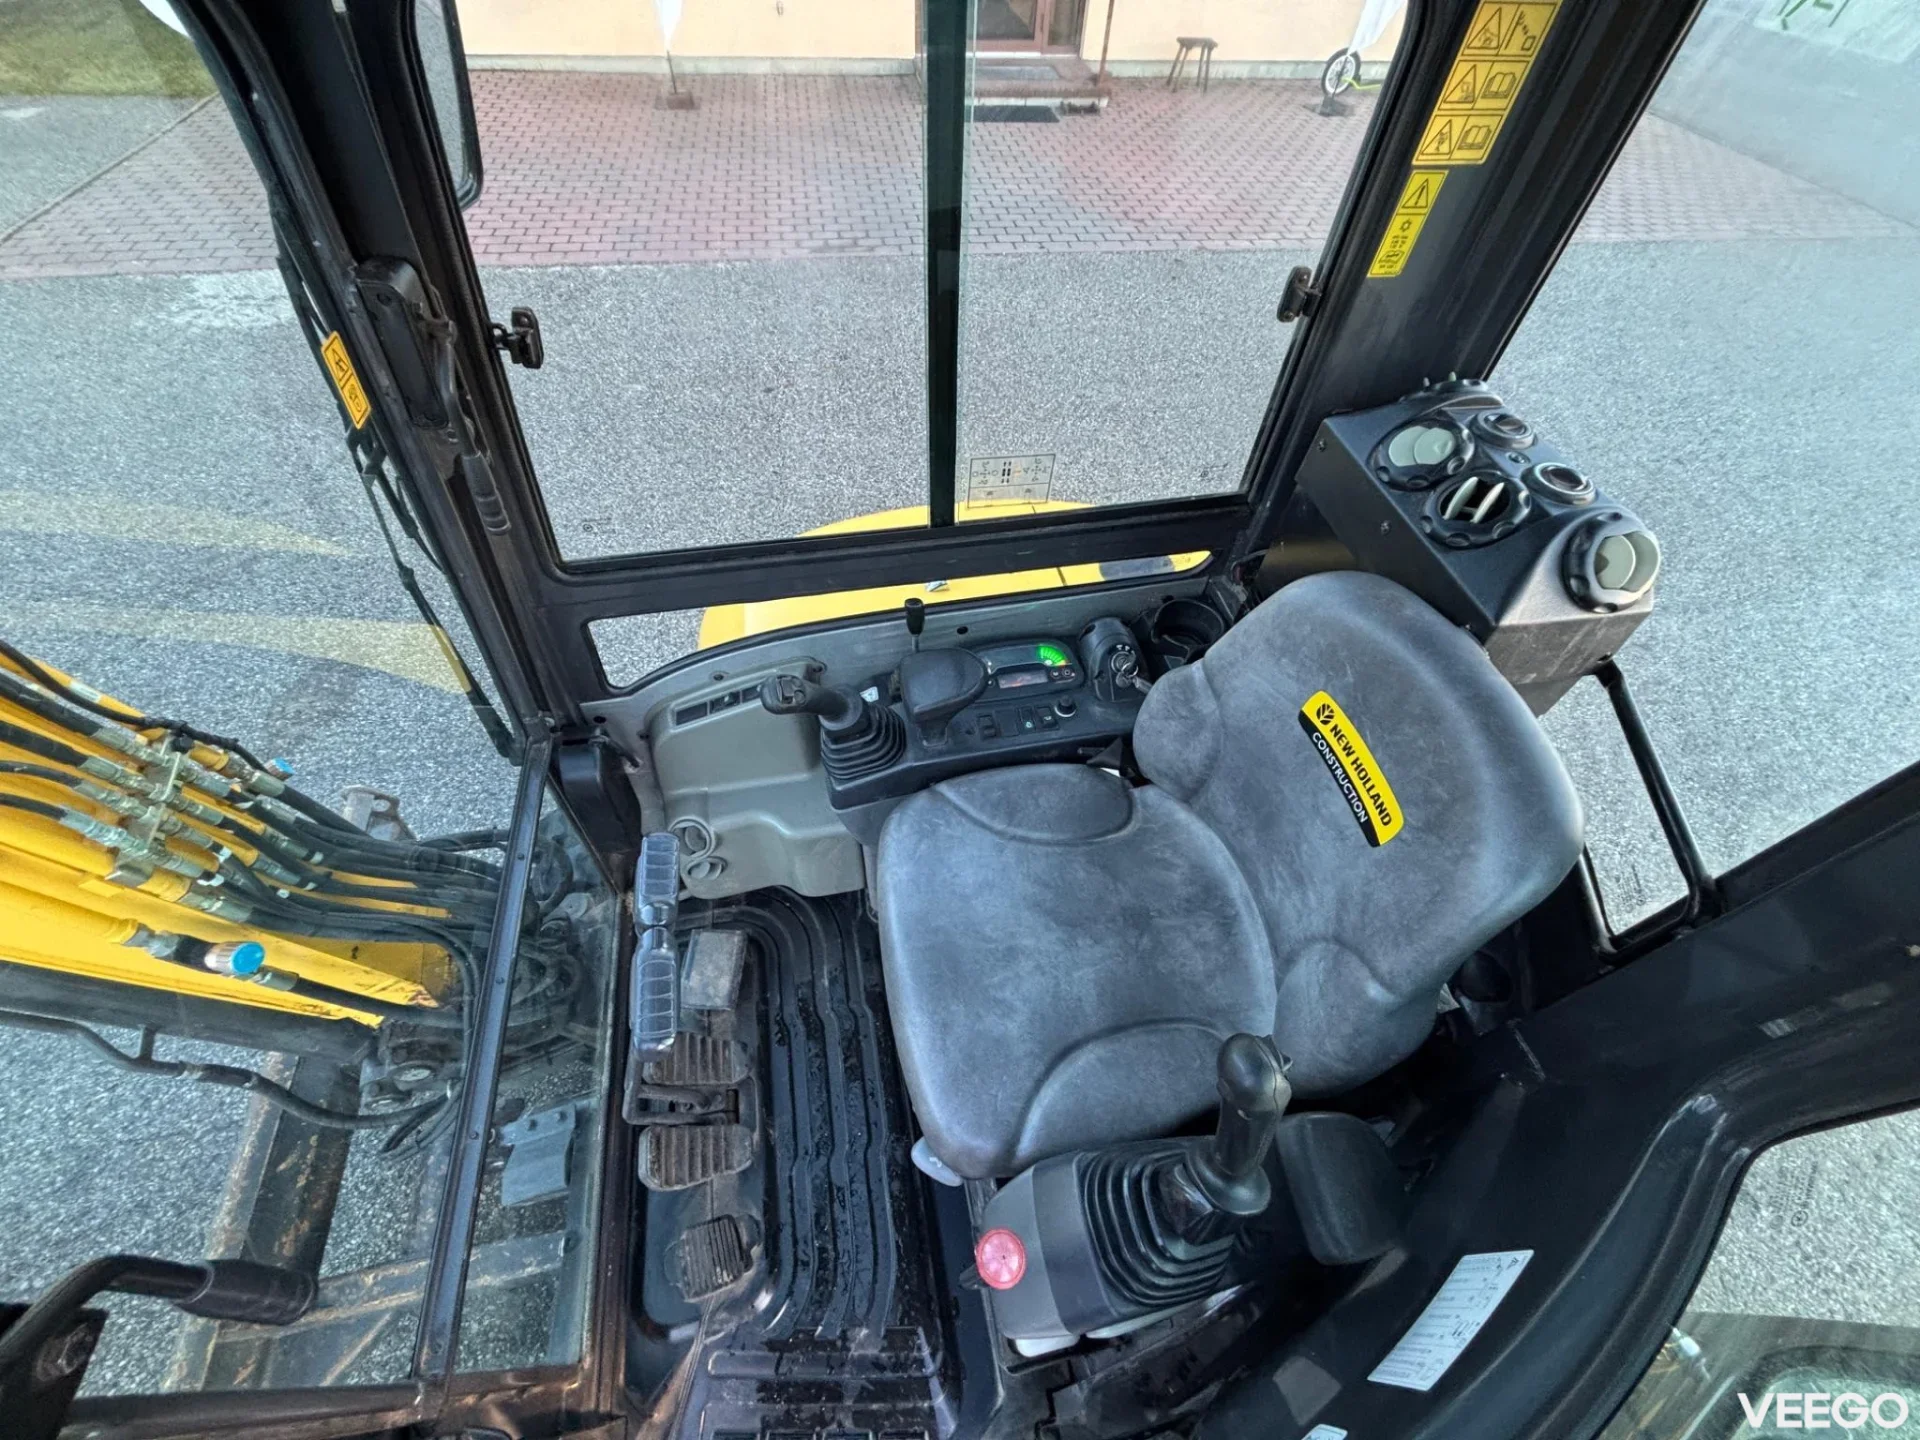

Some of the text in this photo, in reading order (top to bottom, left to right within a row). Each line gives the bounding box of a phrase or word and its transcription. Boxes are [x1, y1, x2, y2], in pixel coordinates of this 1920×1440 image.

[1312, 732, 1368, 823] CONSTRUCTION
[1330, 724, 1392, 826] NEW HOLLAND
